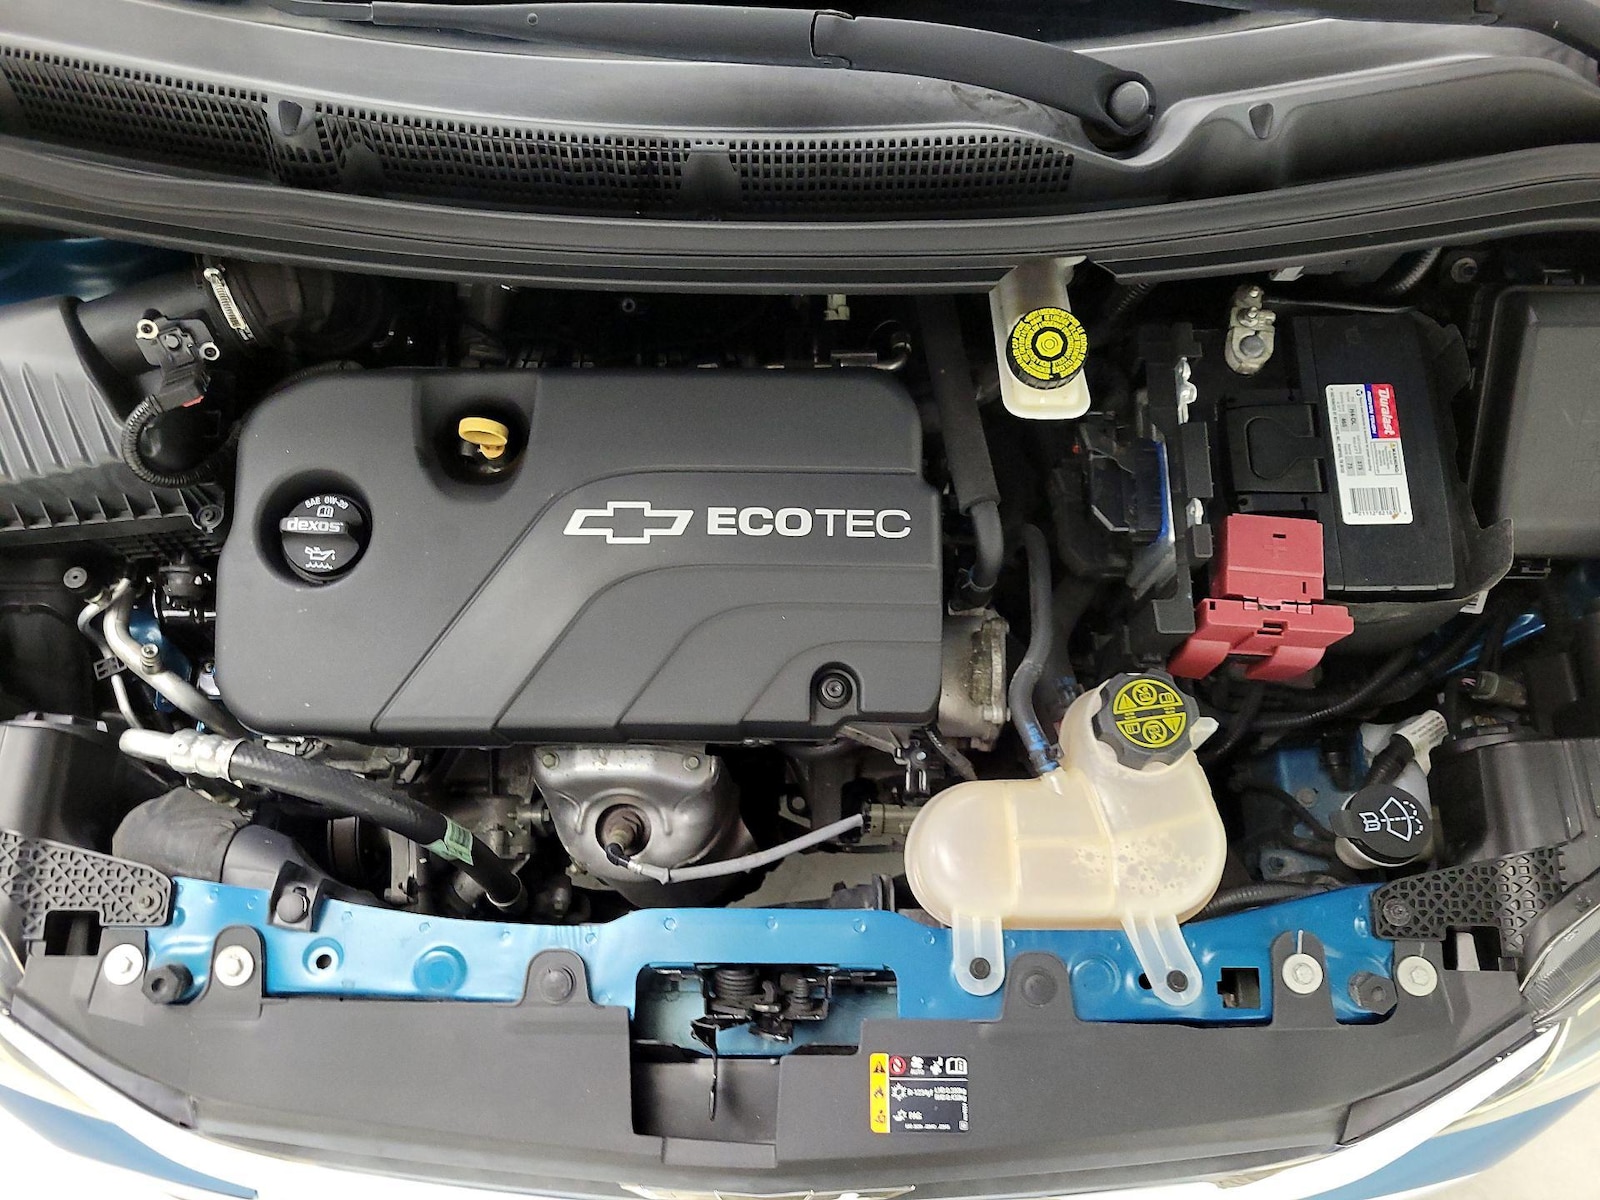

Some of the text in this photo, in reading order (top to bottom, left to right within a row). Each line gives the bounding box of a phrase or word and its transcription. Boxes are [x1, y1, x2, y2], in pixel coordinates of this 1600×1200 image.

[1378, 388, 1396, 436] Duralast
[324, 495, 349, 510] 0W-20
[287, 517, 341, 533] dexos
[707, 506, 912, 539] ECOTEC
